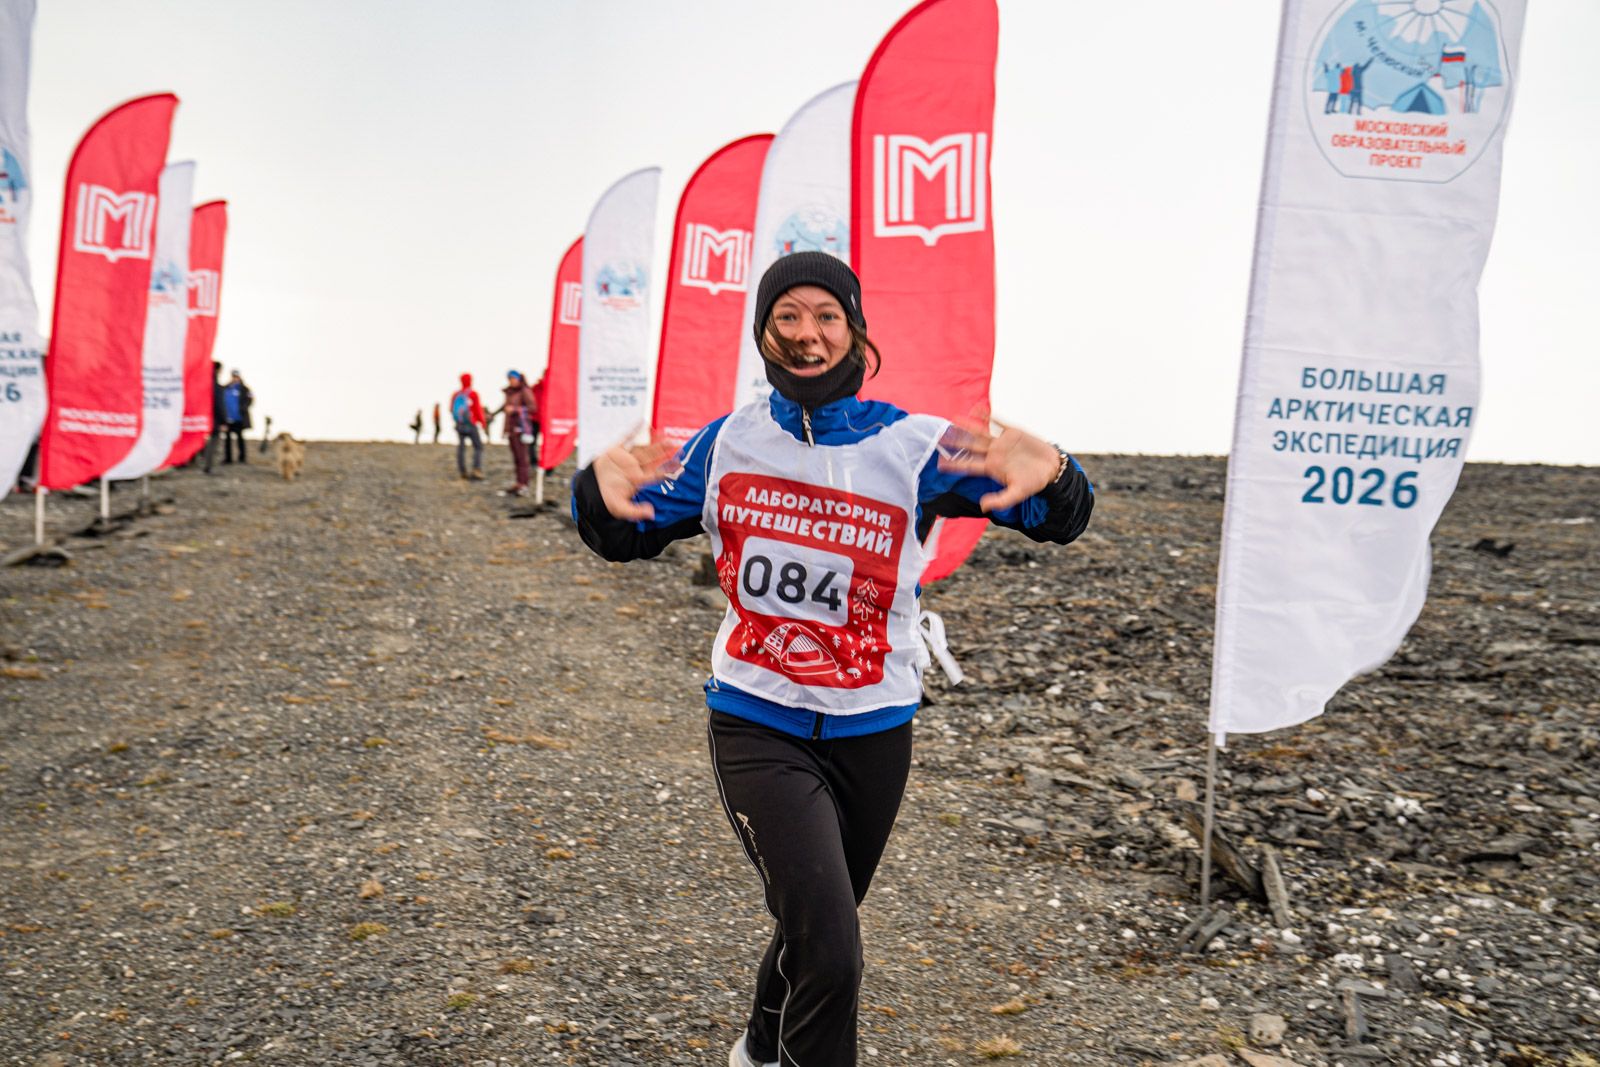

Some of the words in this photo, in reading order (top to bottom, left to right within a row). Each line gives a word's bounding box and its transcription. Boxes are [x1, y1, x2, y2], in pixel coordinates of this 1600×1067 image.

[1354, 119, 1449, 136] МОСКОВСКИЙ
[1331, 133, 1467, 156] ОБРАЗОВАТЕЛЬНЫЙ
[1369, 153, 1422, 169] ПРОЕКТ
[1301, 367, 1446, 395] БОЛЬШАЯ
[1267, 398, 1473, 428] АРКТИЧЕСКАЯ
[1272, 430, 1462, 463] ЭКСПЕДИЦИЯ
[1301, 465, 1419, 509] 2026
[745, 486, 891, 529] ЛАБОРАТОРИЯ
[722, 504, 894, 558] ПУТЕШЕСТВИЙ
[743, 554, 841, 611] 084
